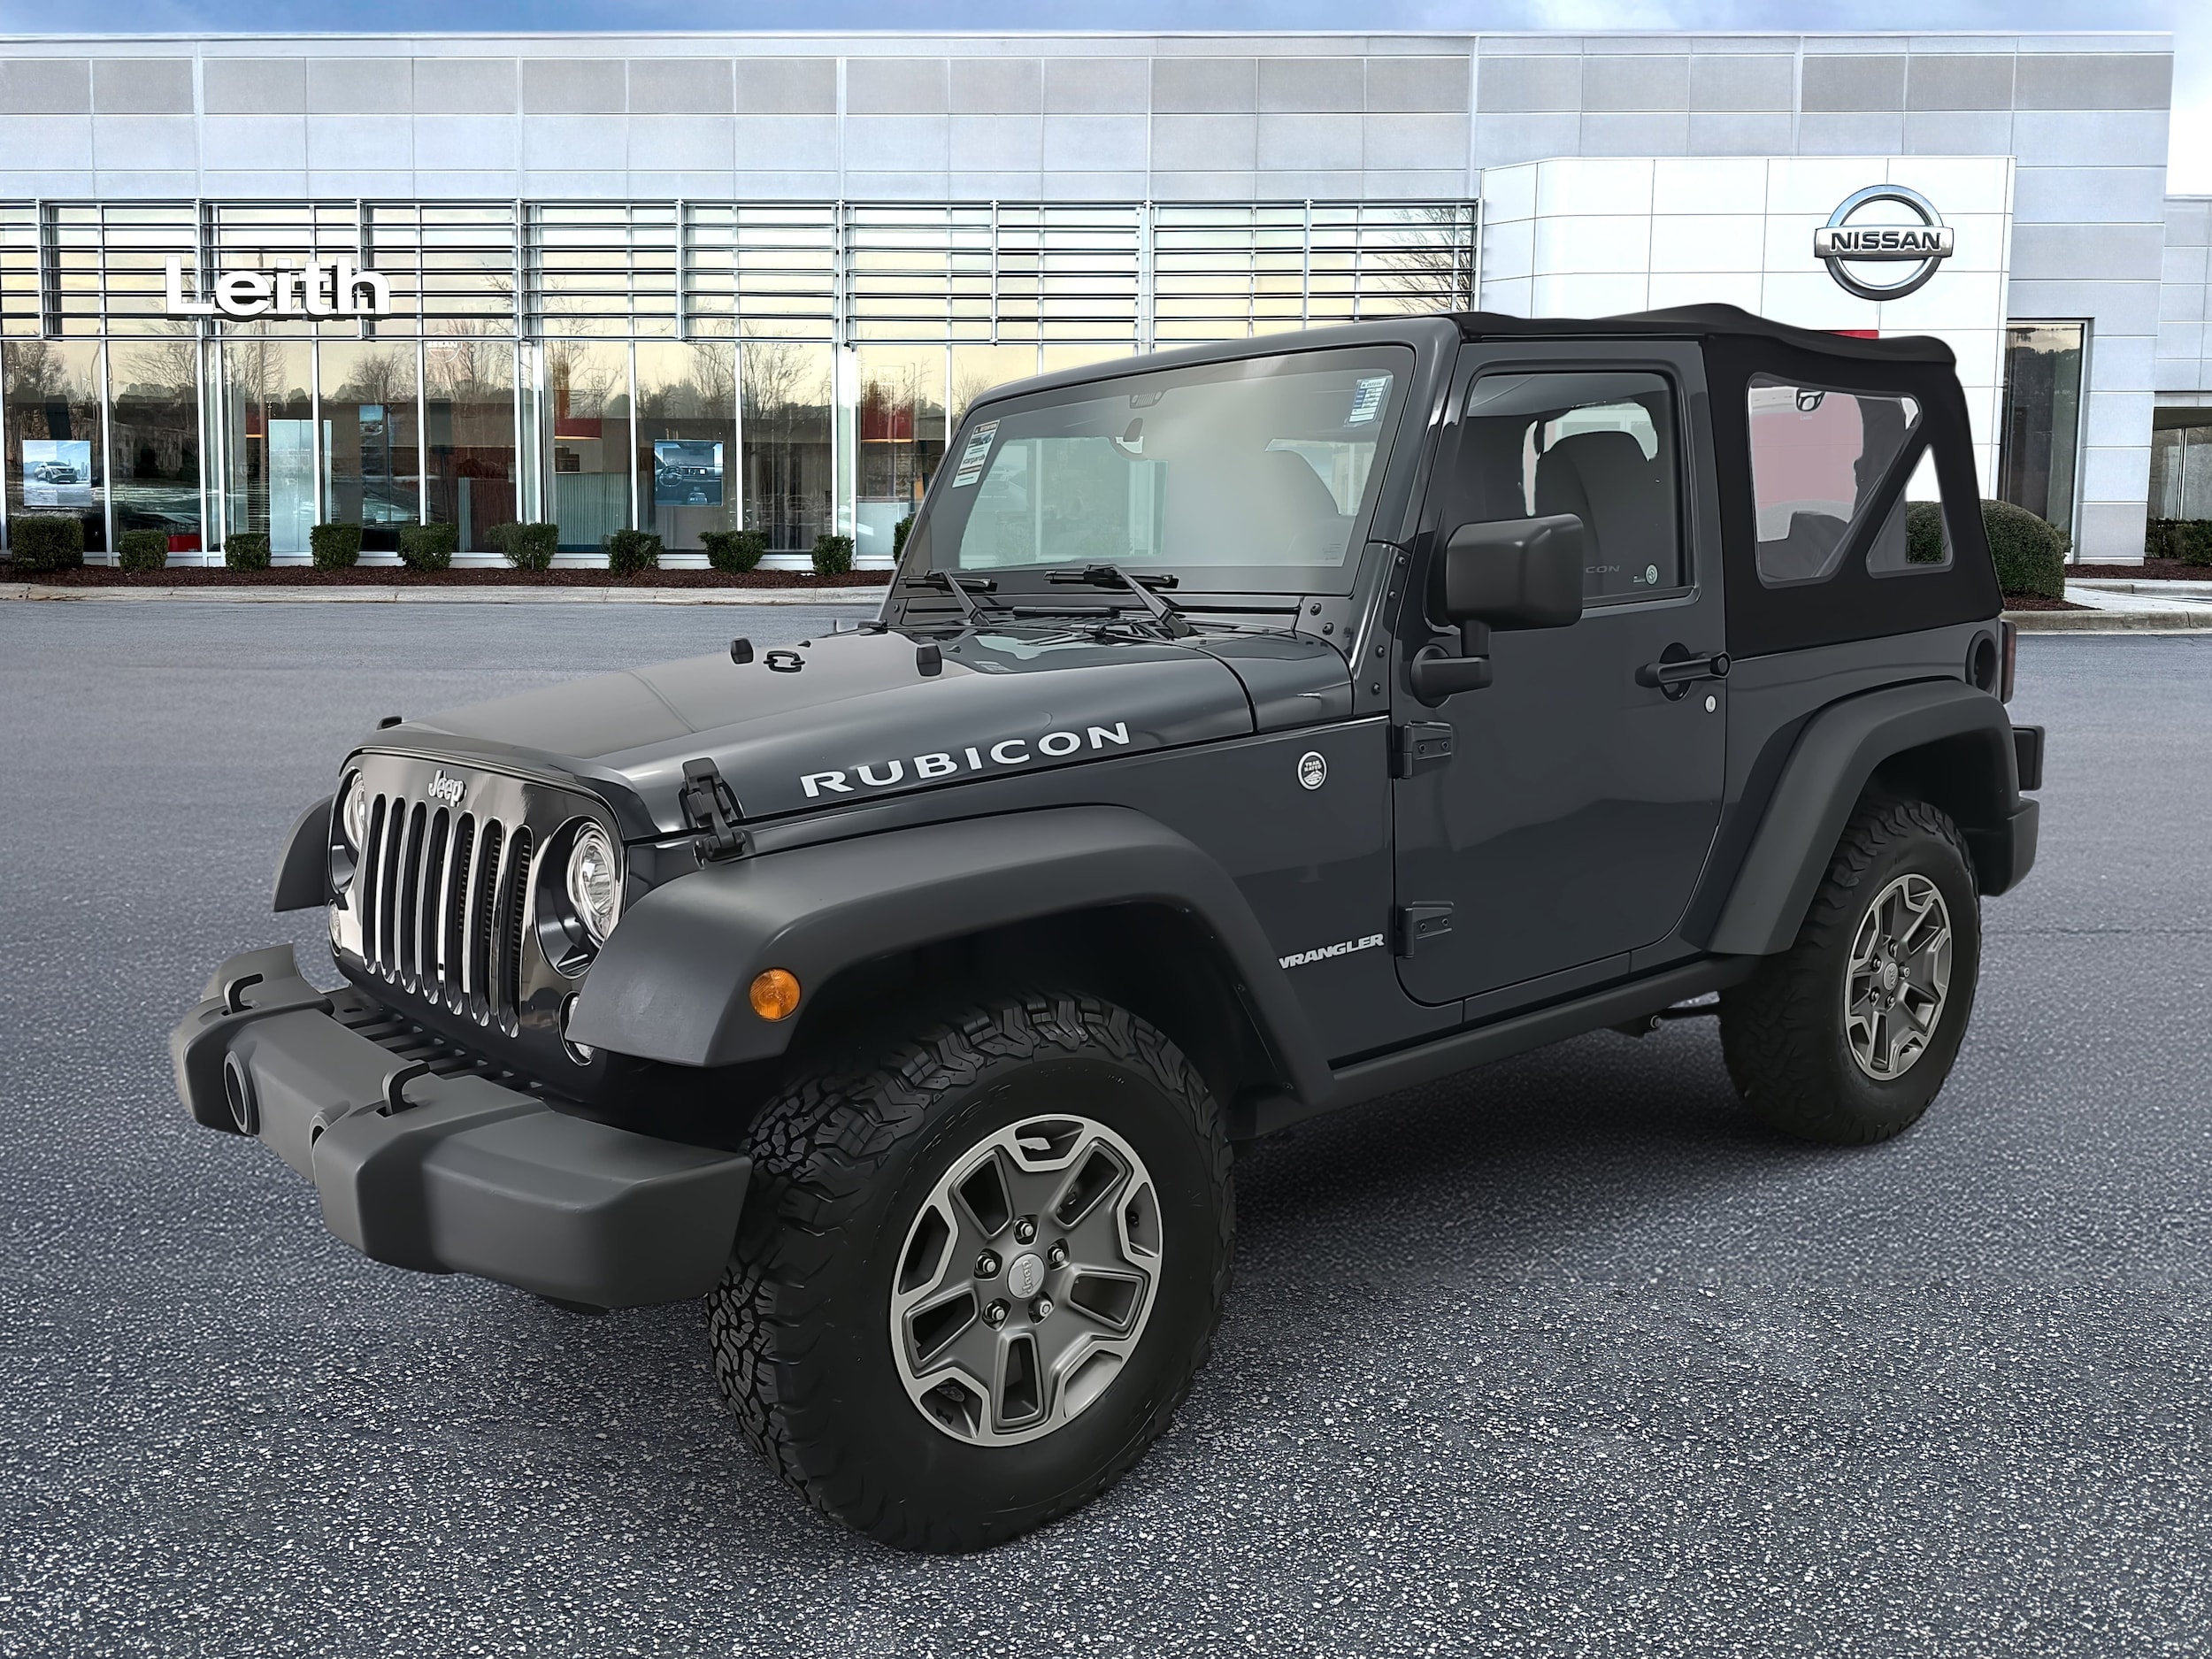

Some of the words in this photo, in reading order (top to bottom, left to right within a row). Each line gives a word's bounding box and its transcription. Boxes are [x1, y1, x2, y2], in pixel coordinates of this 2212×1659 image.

[1830, 231, 1941, 251] NISSAN
[165, 256, 390, 316] Leith
[800, 722, 1130, 797] RUBICON
[428, 770, 466, 807] Jeep
[1022, 1260, 1033, 1294] Jeep
